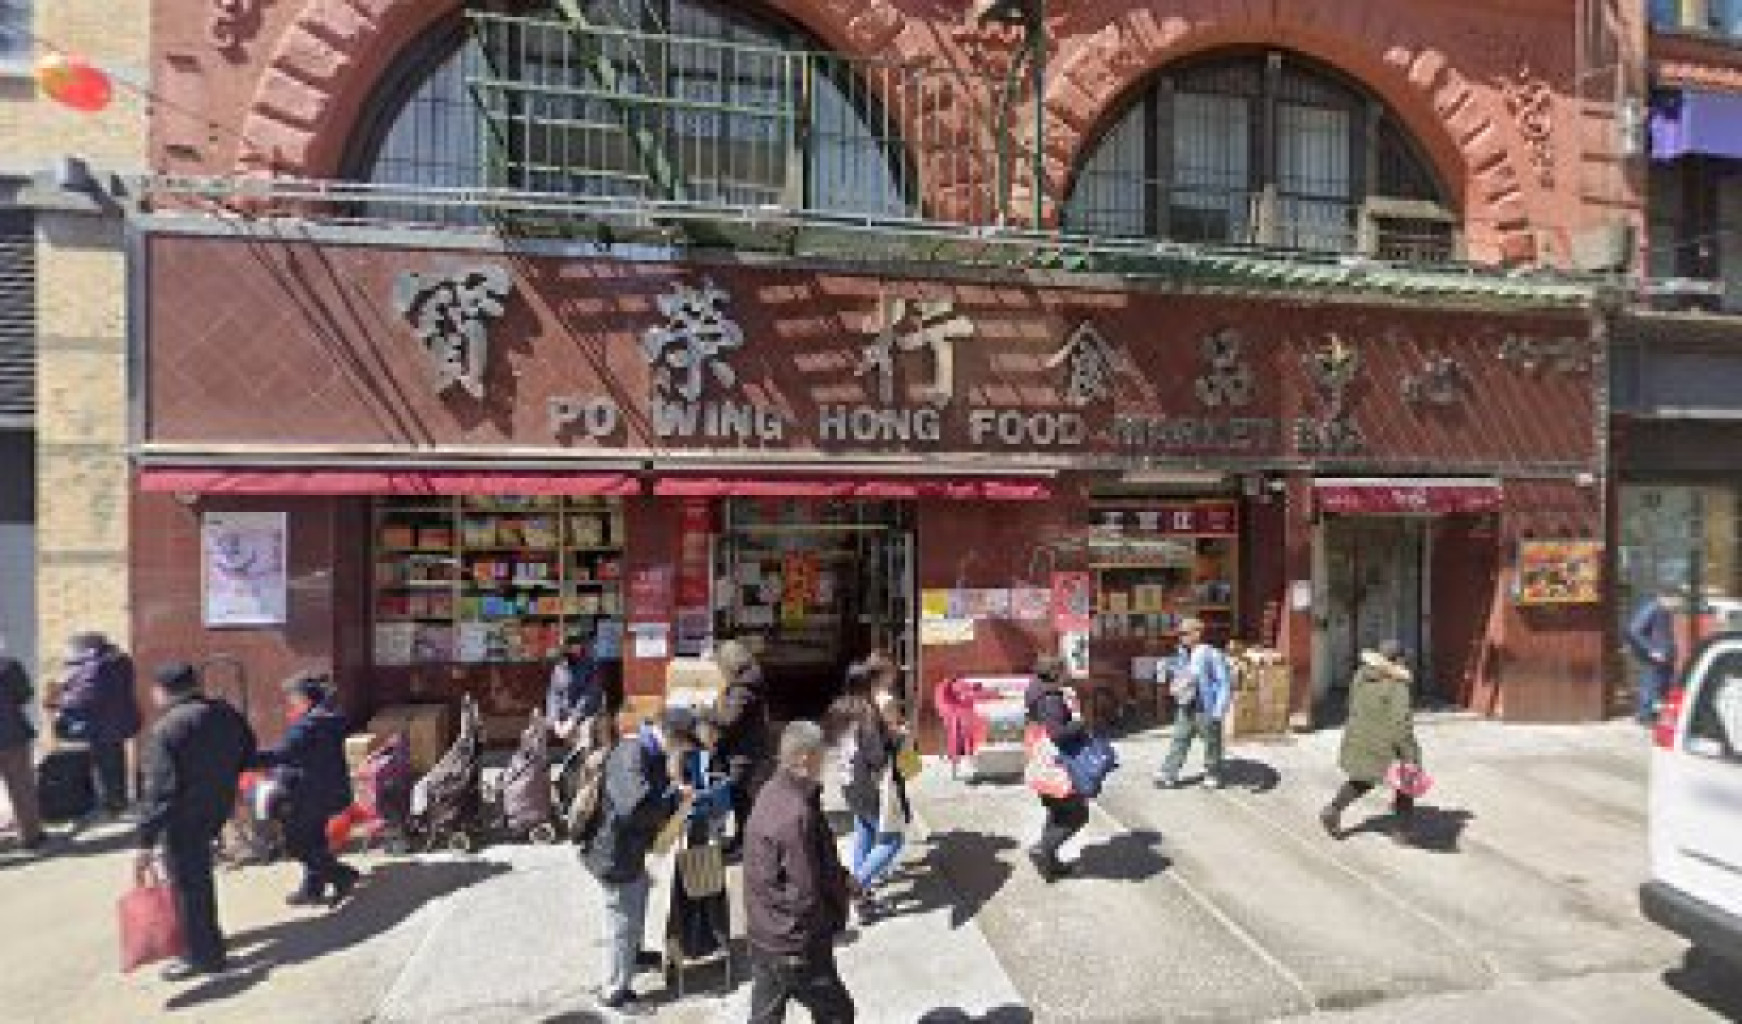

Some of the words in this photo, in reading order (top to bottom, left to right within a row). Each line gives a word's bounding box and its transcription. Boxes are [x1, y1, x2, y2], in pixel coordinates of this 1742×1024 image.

[547, 396, 619, 436] PO
[651, 401, 783, 441] WING
[819, 404, 940, 441] HONG
[968, 409, 1086, 445] FOOD
